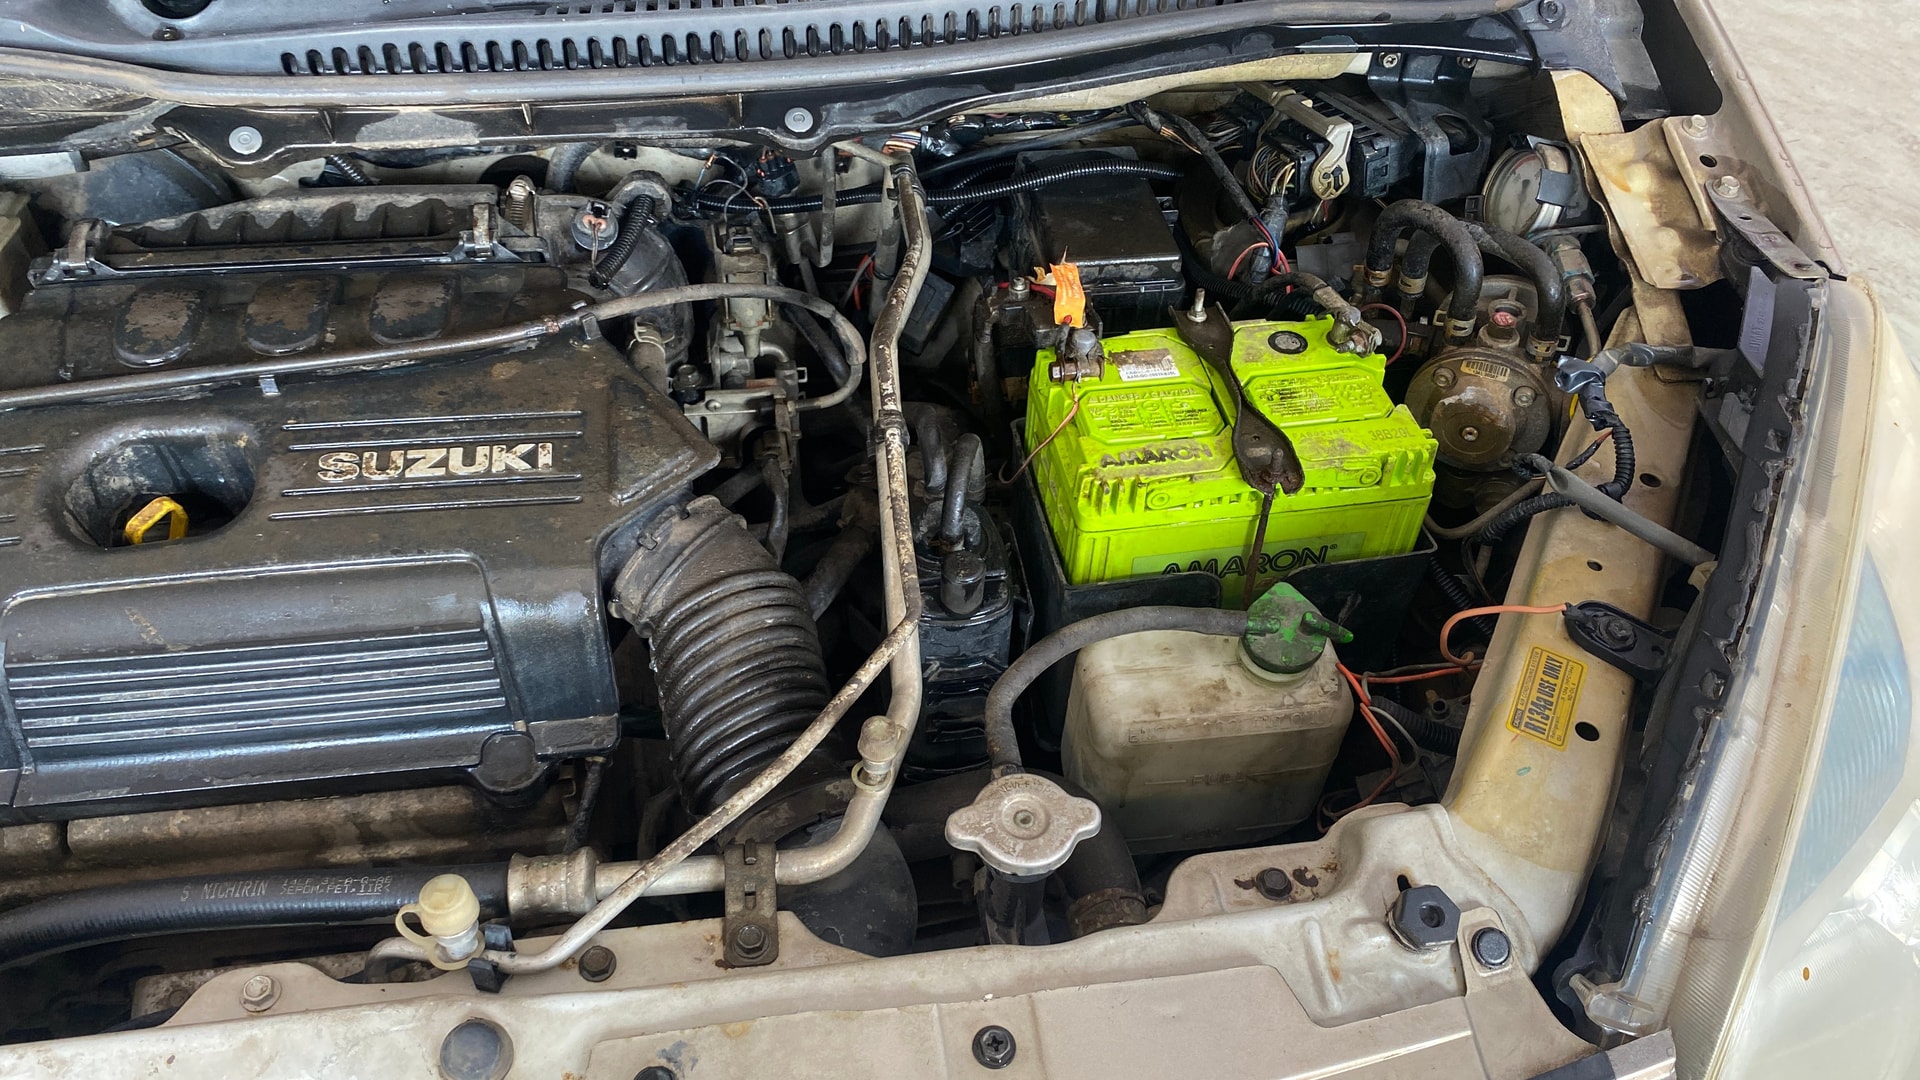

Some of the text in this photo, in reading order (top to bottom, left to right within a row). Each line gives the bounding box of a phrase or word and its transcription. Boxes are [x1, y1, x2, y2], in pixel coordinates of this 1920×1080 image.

[317, 442, 553, 482] SUZUKI
[1100, 446, 1213, 468] AMARON
[1523, 655, 1564, 735] R134a USE ONLY
[201, 879, 270, 900] NICHIRIN
